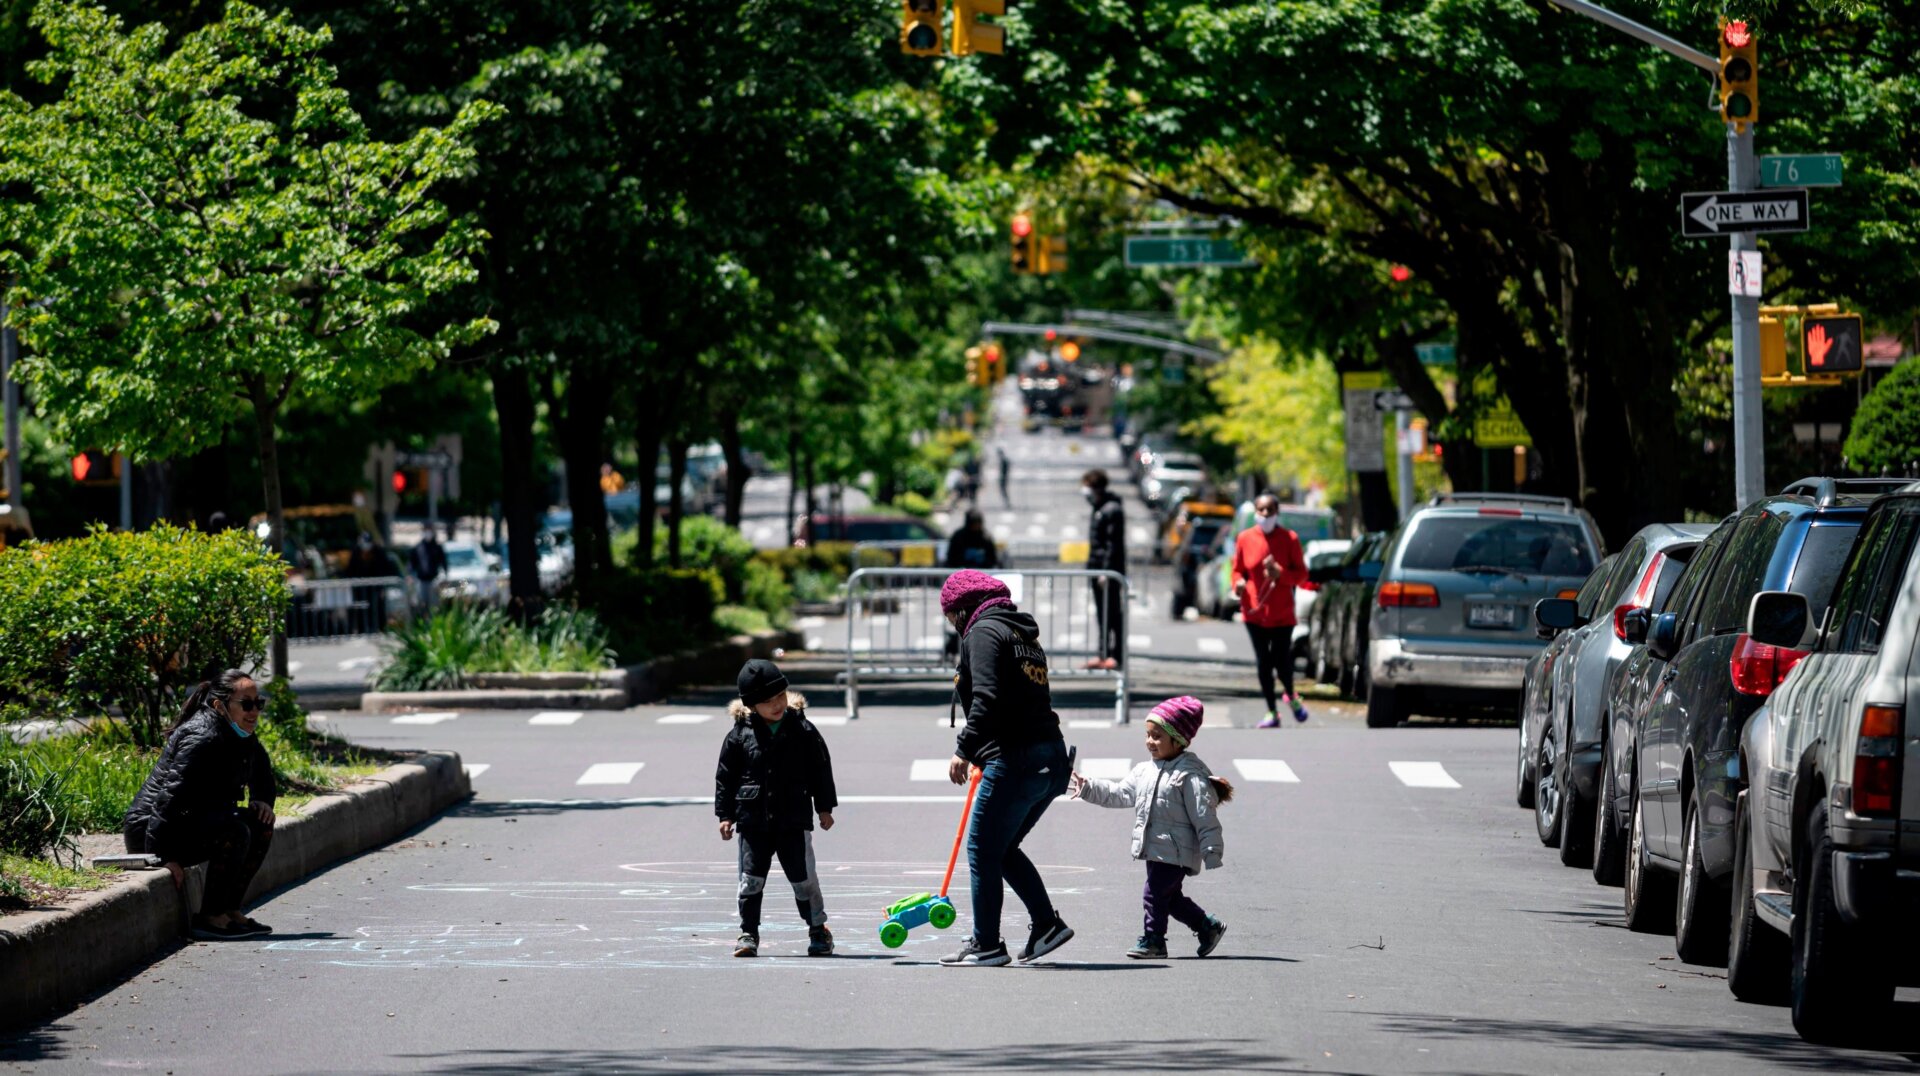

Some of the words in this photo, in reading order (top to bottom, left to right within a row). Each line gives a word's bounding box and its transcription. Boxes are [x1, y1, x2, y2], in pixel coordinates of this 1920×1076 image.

[1772, 159, 1799, 182] 76
[1825, 158, 1837, 171] ST
[1706, 205, 1742, 222] ONE
[1752, 202, 1790, 219] WAY
